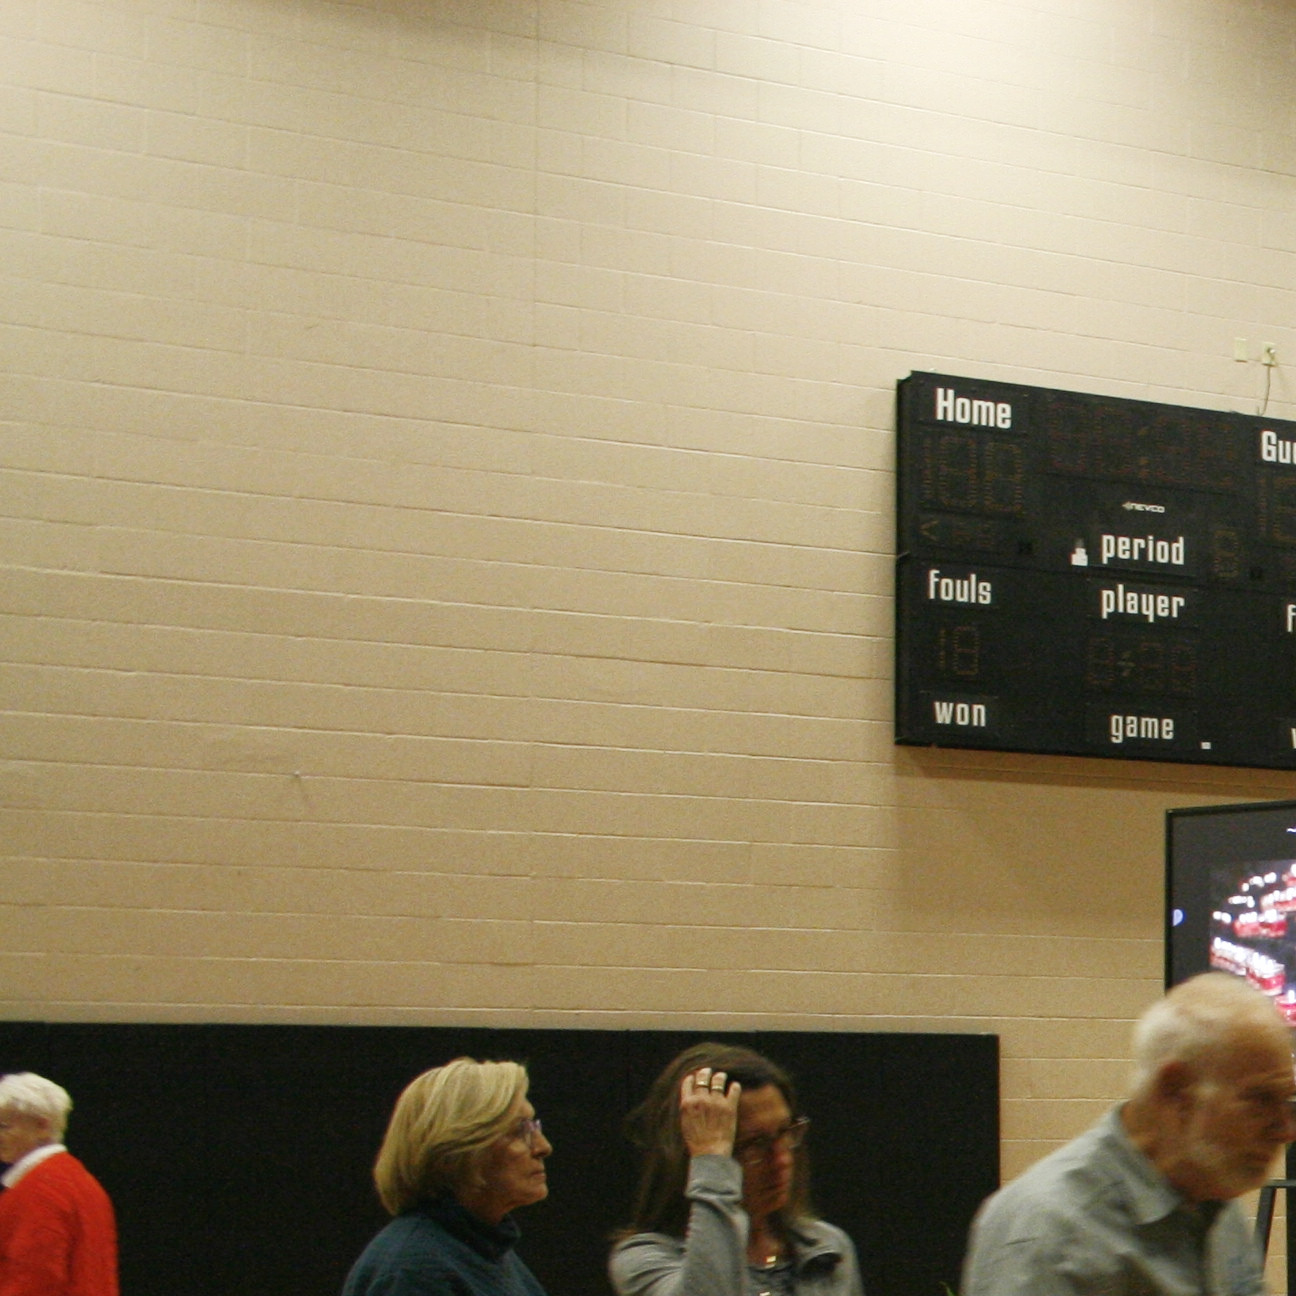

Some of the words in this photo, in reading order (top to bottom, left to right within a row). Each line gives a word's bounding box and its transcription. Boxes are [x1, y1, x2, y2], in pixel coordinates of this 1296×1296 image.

[936, 387, 1012, 429] Home
[1101, 534, 1185, 565] period
[929, 569, 992, 605] fouls
[1101, 584, 1185, 623] player
[934, 701, 986, 727] won
[1111, 714, 1174, 744] game
